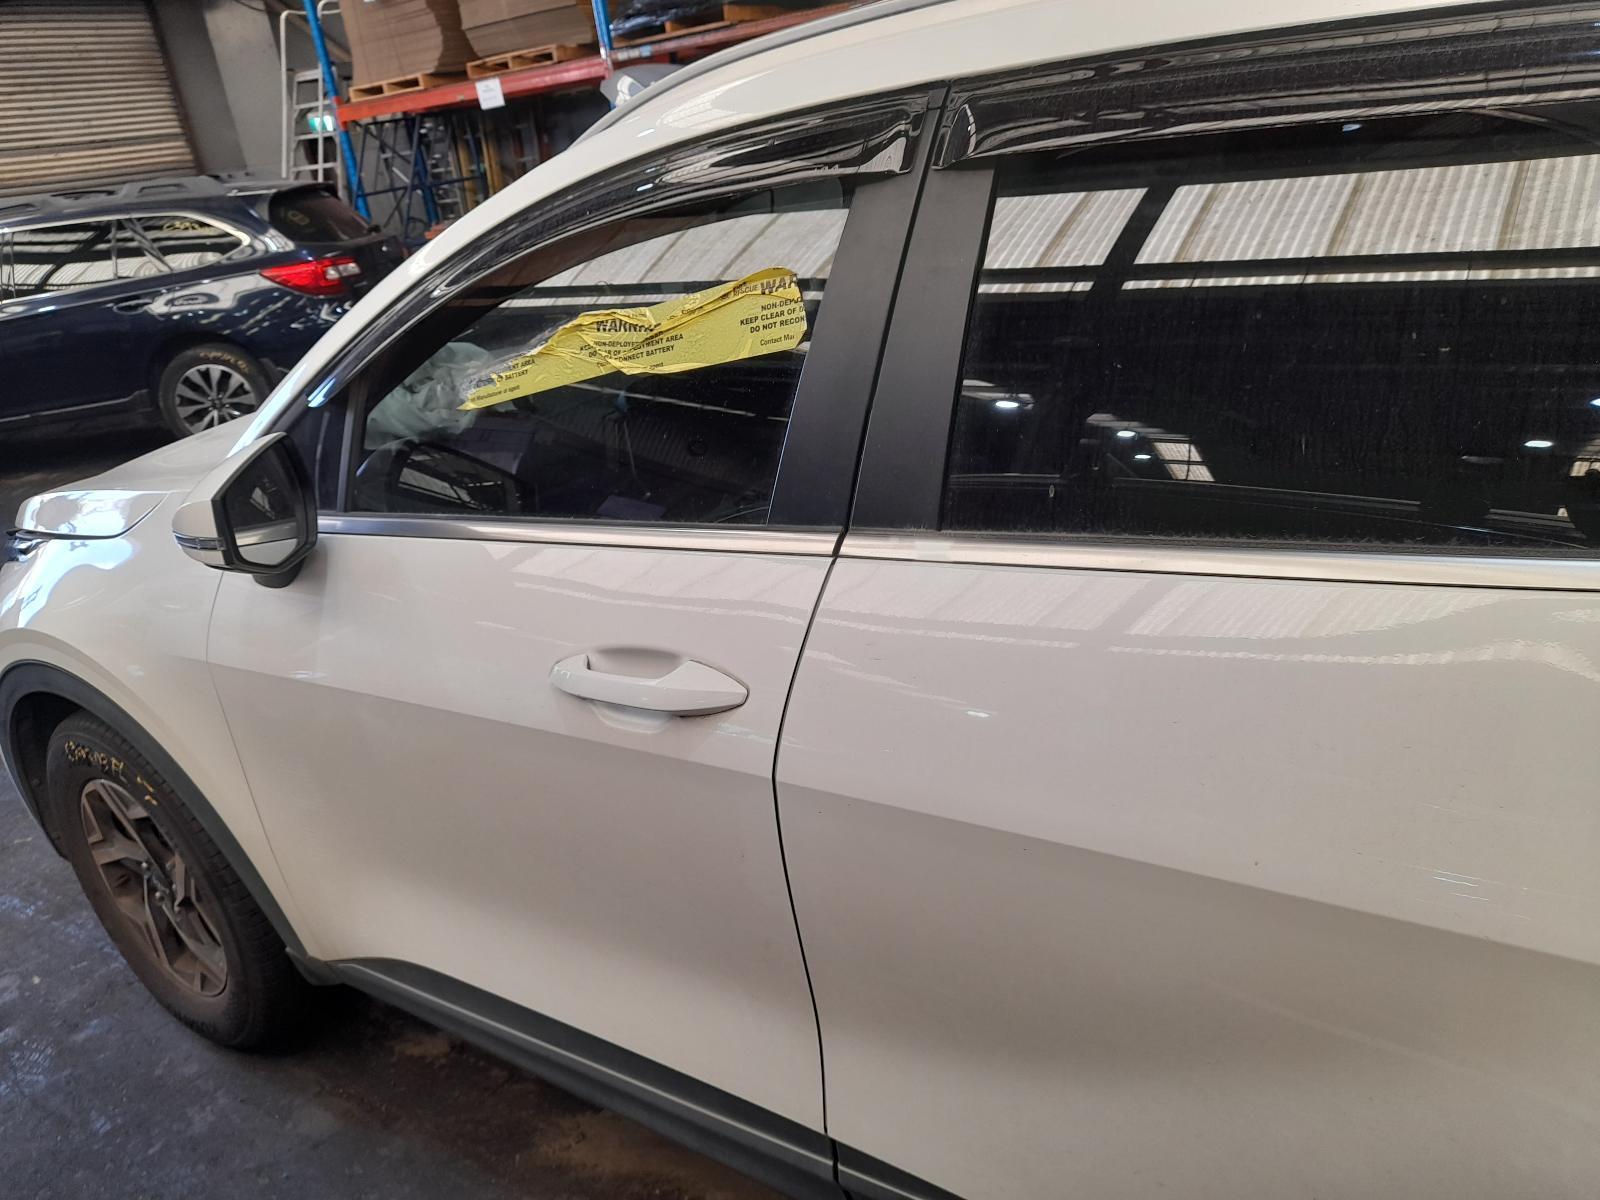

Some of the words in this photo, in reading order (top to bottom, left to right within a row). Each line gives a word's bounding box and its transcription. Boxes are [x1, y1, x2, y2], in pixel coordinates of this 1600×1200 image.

[740, 315, 759, 326] KEEP
[760, 310, 785, 322] CLEAR
[786, 307, 797, 316] OF
[750, 325, 760, 334] DO
[762, 321, 777, 331] NOT
[665, 333, 684, 343] AREA
[760, 336, 783, 346] Contact
[645, 344, 676, 356] BATTERY
